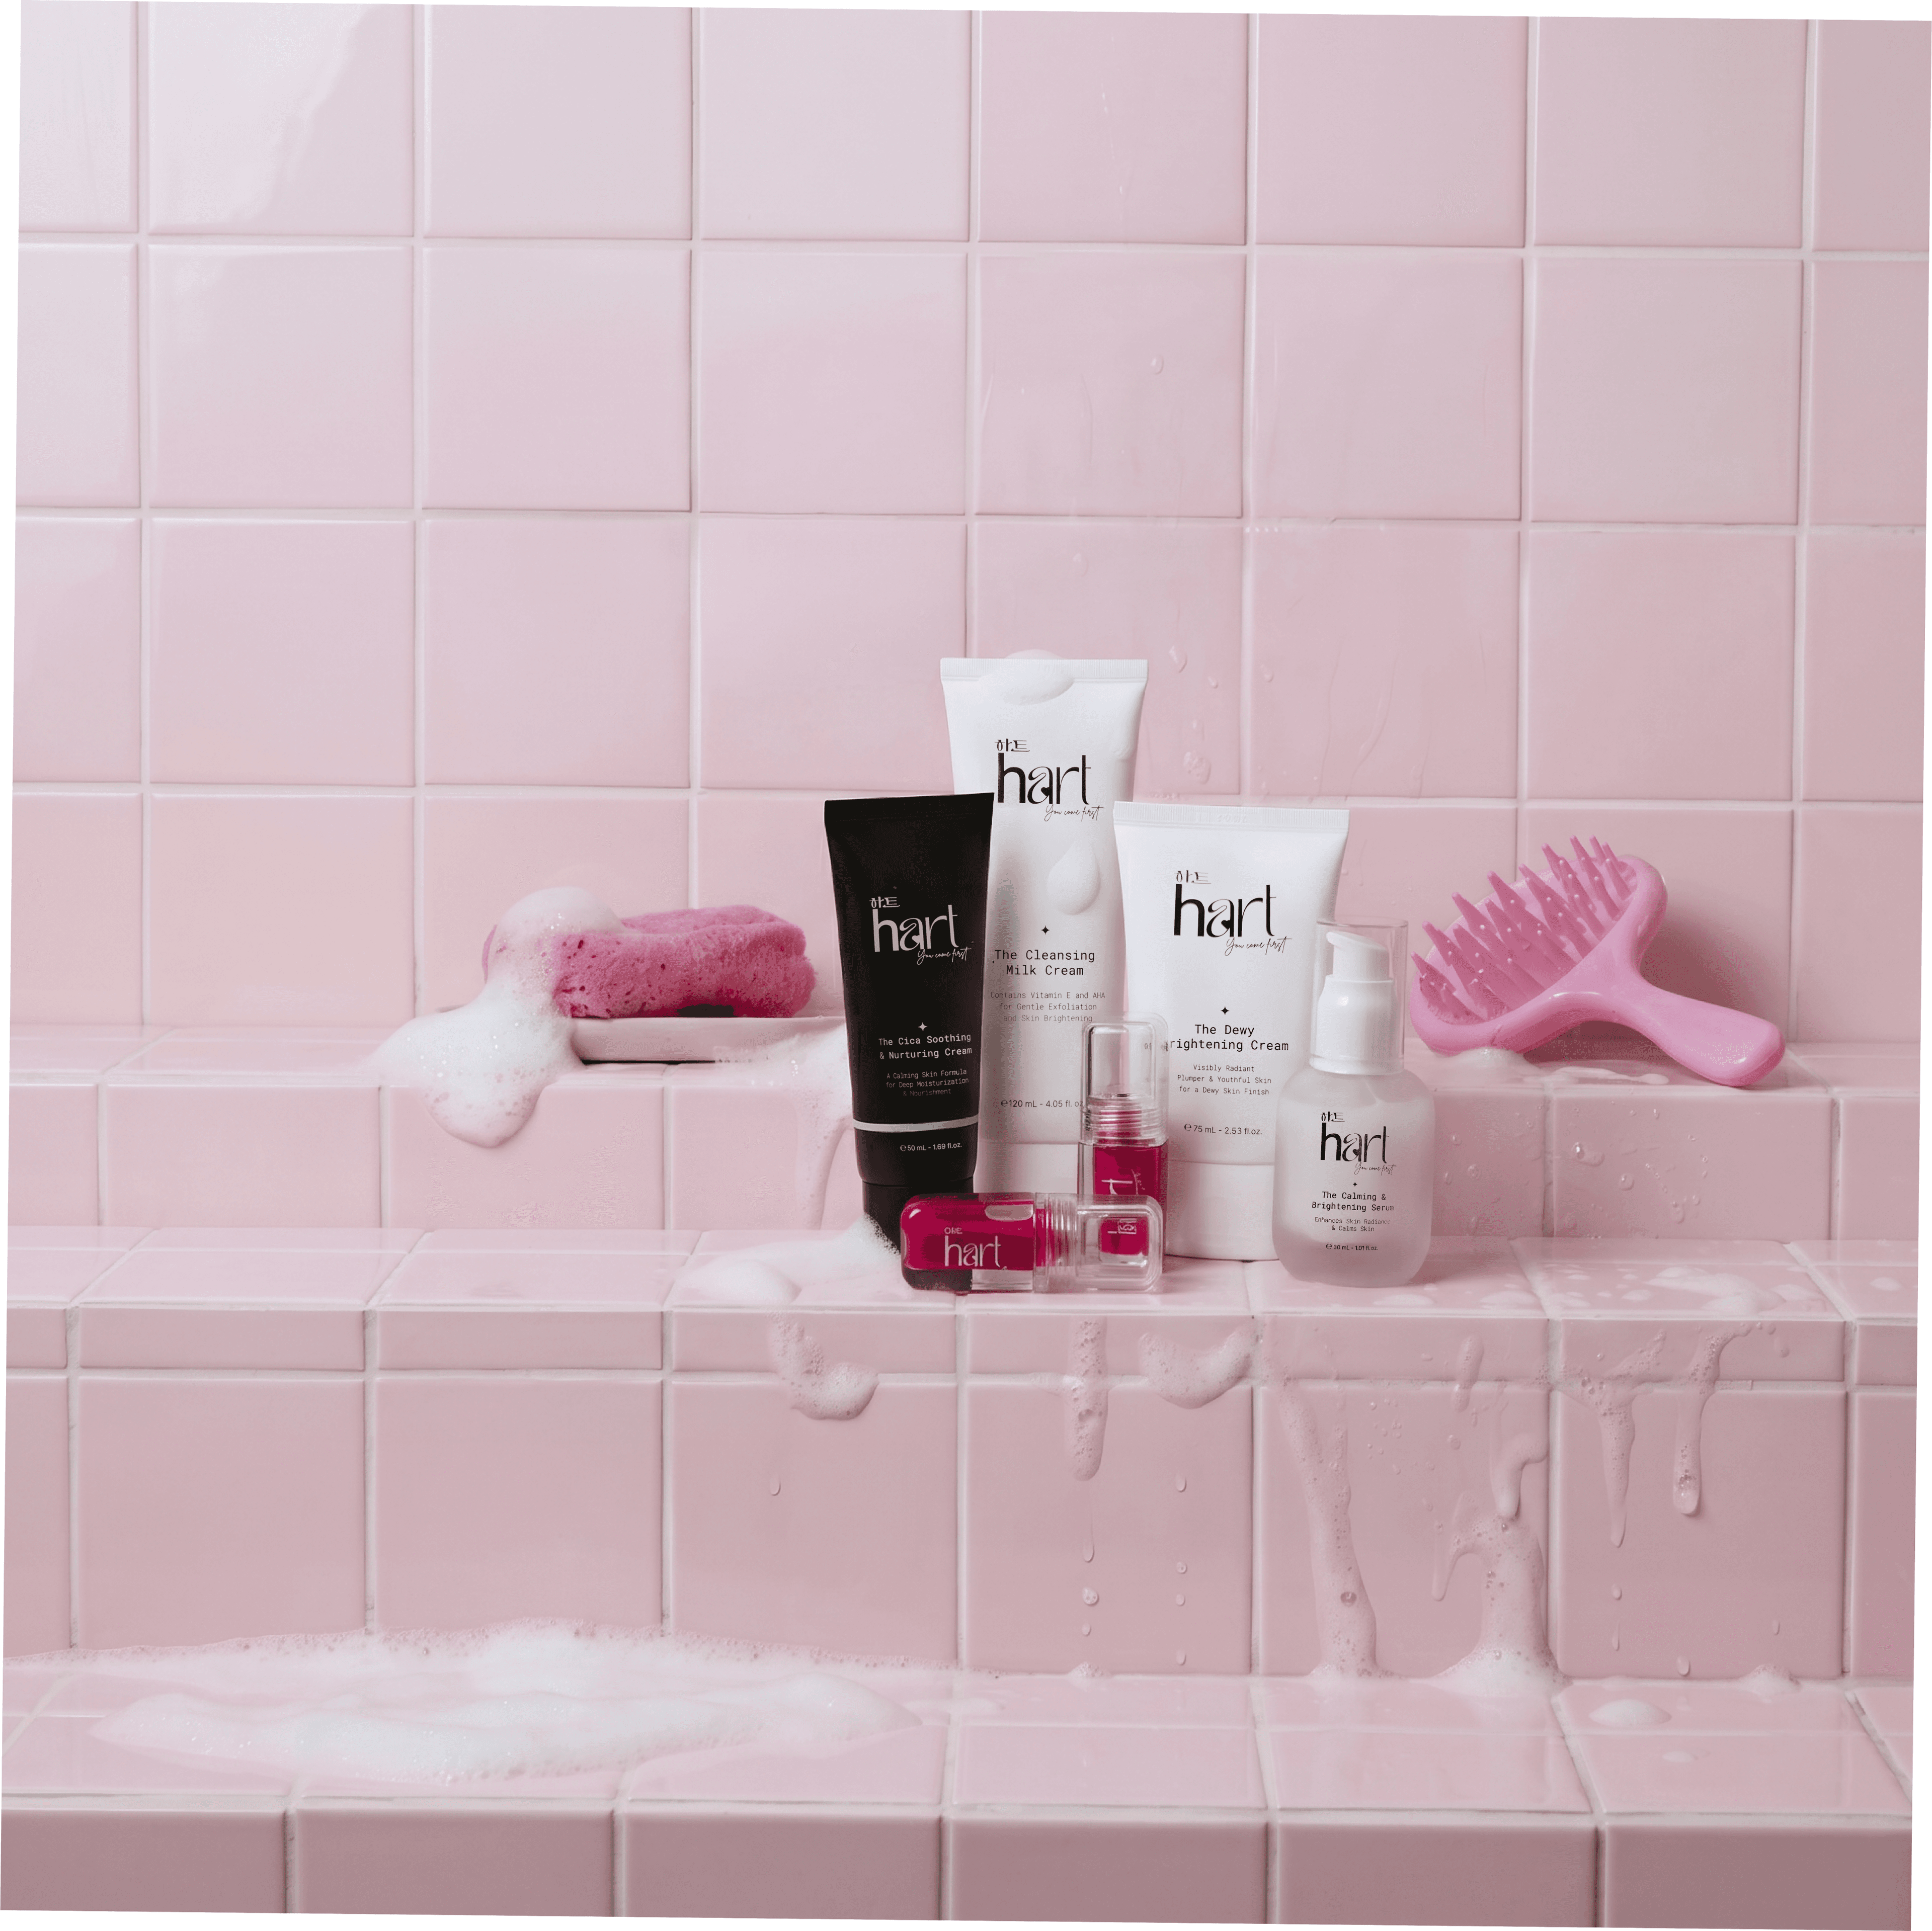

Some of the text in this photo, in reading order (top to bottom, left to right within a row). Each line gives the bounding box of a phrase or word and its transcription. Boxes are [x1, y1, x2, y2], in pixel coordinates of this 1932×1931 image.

[995, 738, 1030, 752] 하트
[998, 752, 1091, 805] hart
[1044, 804, 1062, 821] You
[1081, 805, 1105, 821] first
[1174, 870, 1212, 884] 하트
[869, 896, 900, 908] 하트
[1174, 884, 1276, 938] hart
[872, 904, 959, 952] hart
[1225, 938, 1244, 956] You
[1265, 936, 1292, 955] first
[917, 949, 934, 965] You
[951, 947, 972, 963] first
[995, 950, 1095, 963] The Cleansing
[1006, 965, 1084, 975] Milk Cream
[1044, 1015, 1092, 1023] Brightening
[1194, 1024, 1254, 1037] The Dewy
[878, 1038, 893, 1046] The
[927, 1034, 971, 1043] Soothing
[1251, 1040, 1289, 1050] Cream
[889, 1050, 939, 1059] Nurturing
[945, 1048, 972, 1056] Cream
[941, 1068, 967, 1076] Formula
[1177, 1074, 1204, 1082] Plumper
[917, 1078, 969, 1087] Moisturization
[910, 1088, 951, 1097] Nourishment
[1202, 1086, 1219, 1095] Dewy
[1320, 1111, 1345, 1122] 하트
[1320, 1122, 1389, 1163] hart
[1354, 1161, 1367, 1175] You
[1381, 1164, 1397, 1176] first
[1342, 1192, 1377, 1202] Calming
[1312, 1201, 1366, 1212] Brightening
[944, 1235, 1001, 1267] hart
